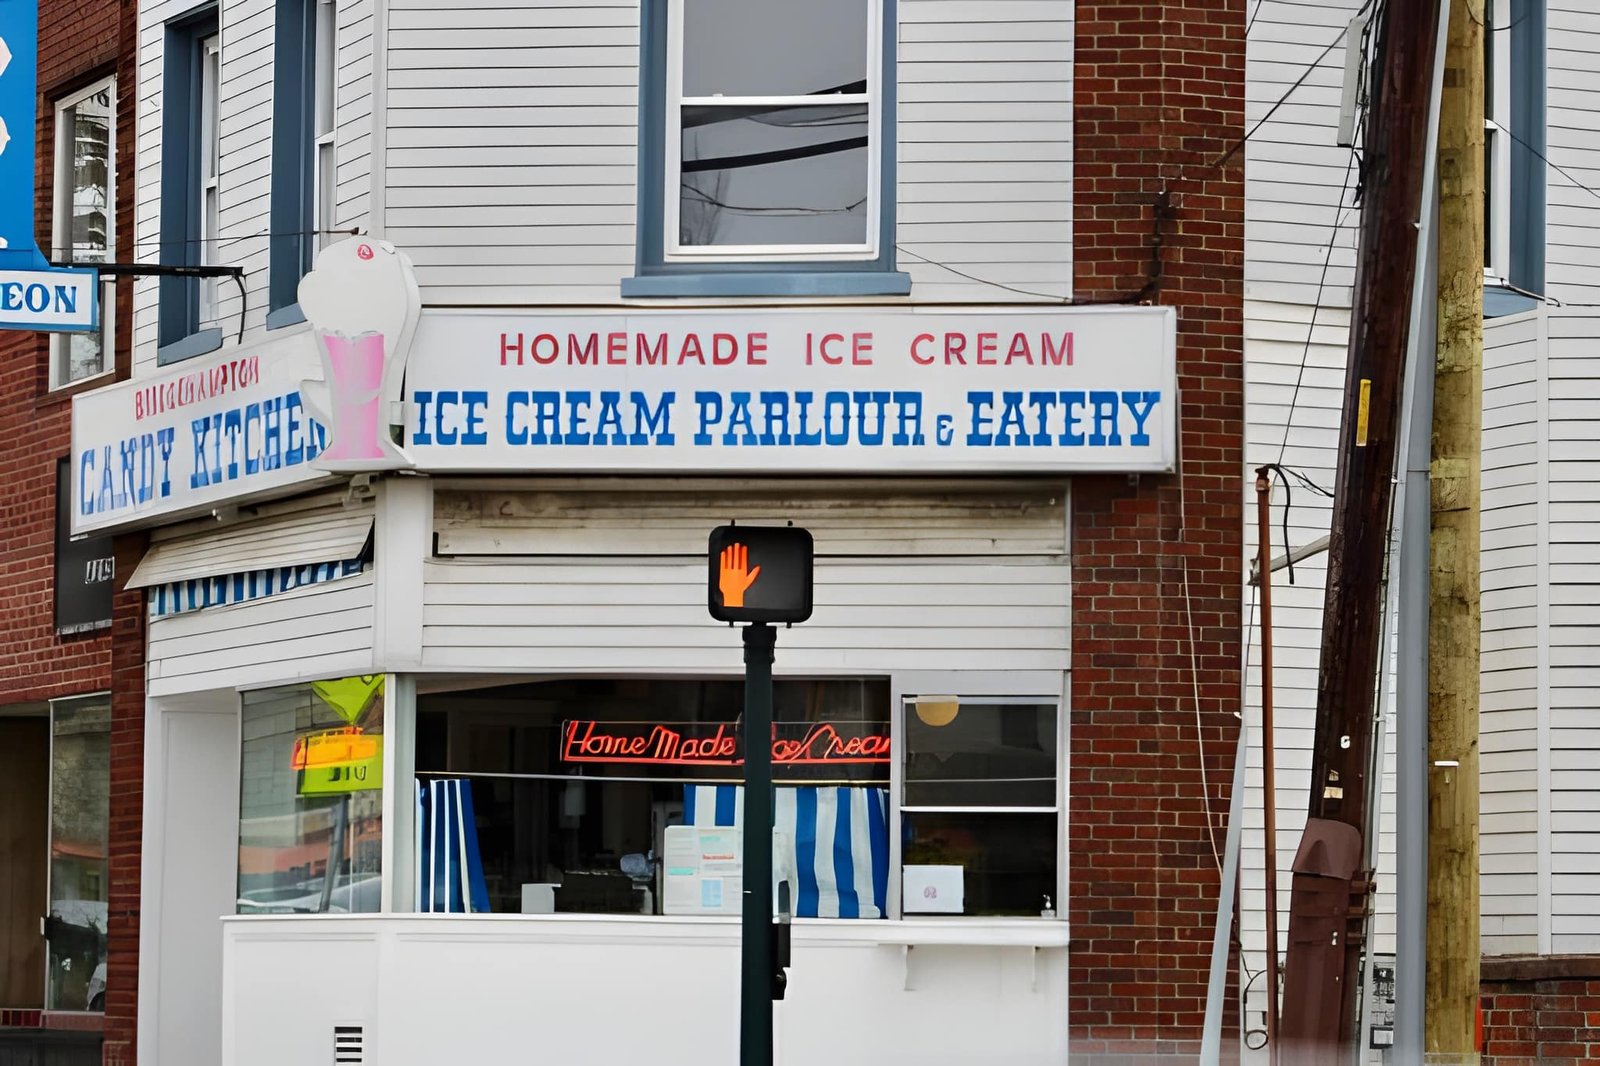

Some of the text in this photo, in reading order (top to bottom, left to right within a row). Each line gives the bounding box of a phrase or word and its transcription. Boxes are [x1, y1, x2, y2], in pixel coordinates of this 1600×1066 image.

[500, 332, 1074, 366] HOMEMADE ICE CREAM
[412, 390, 1162, 447] ICE CREAM PARLOUR & EATERY
[80, 427, 175, 515] CANDY
